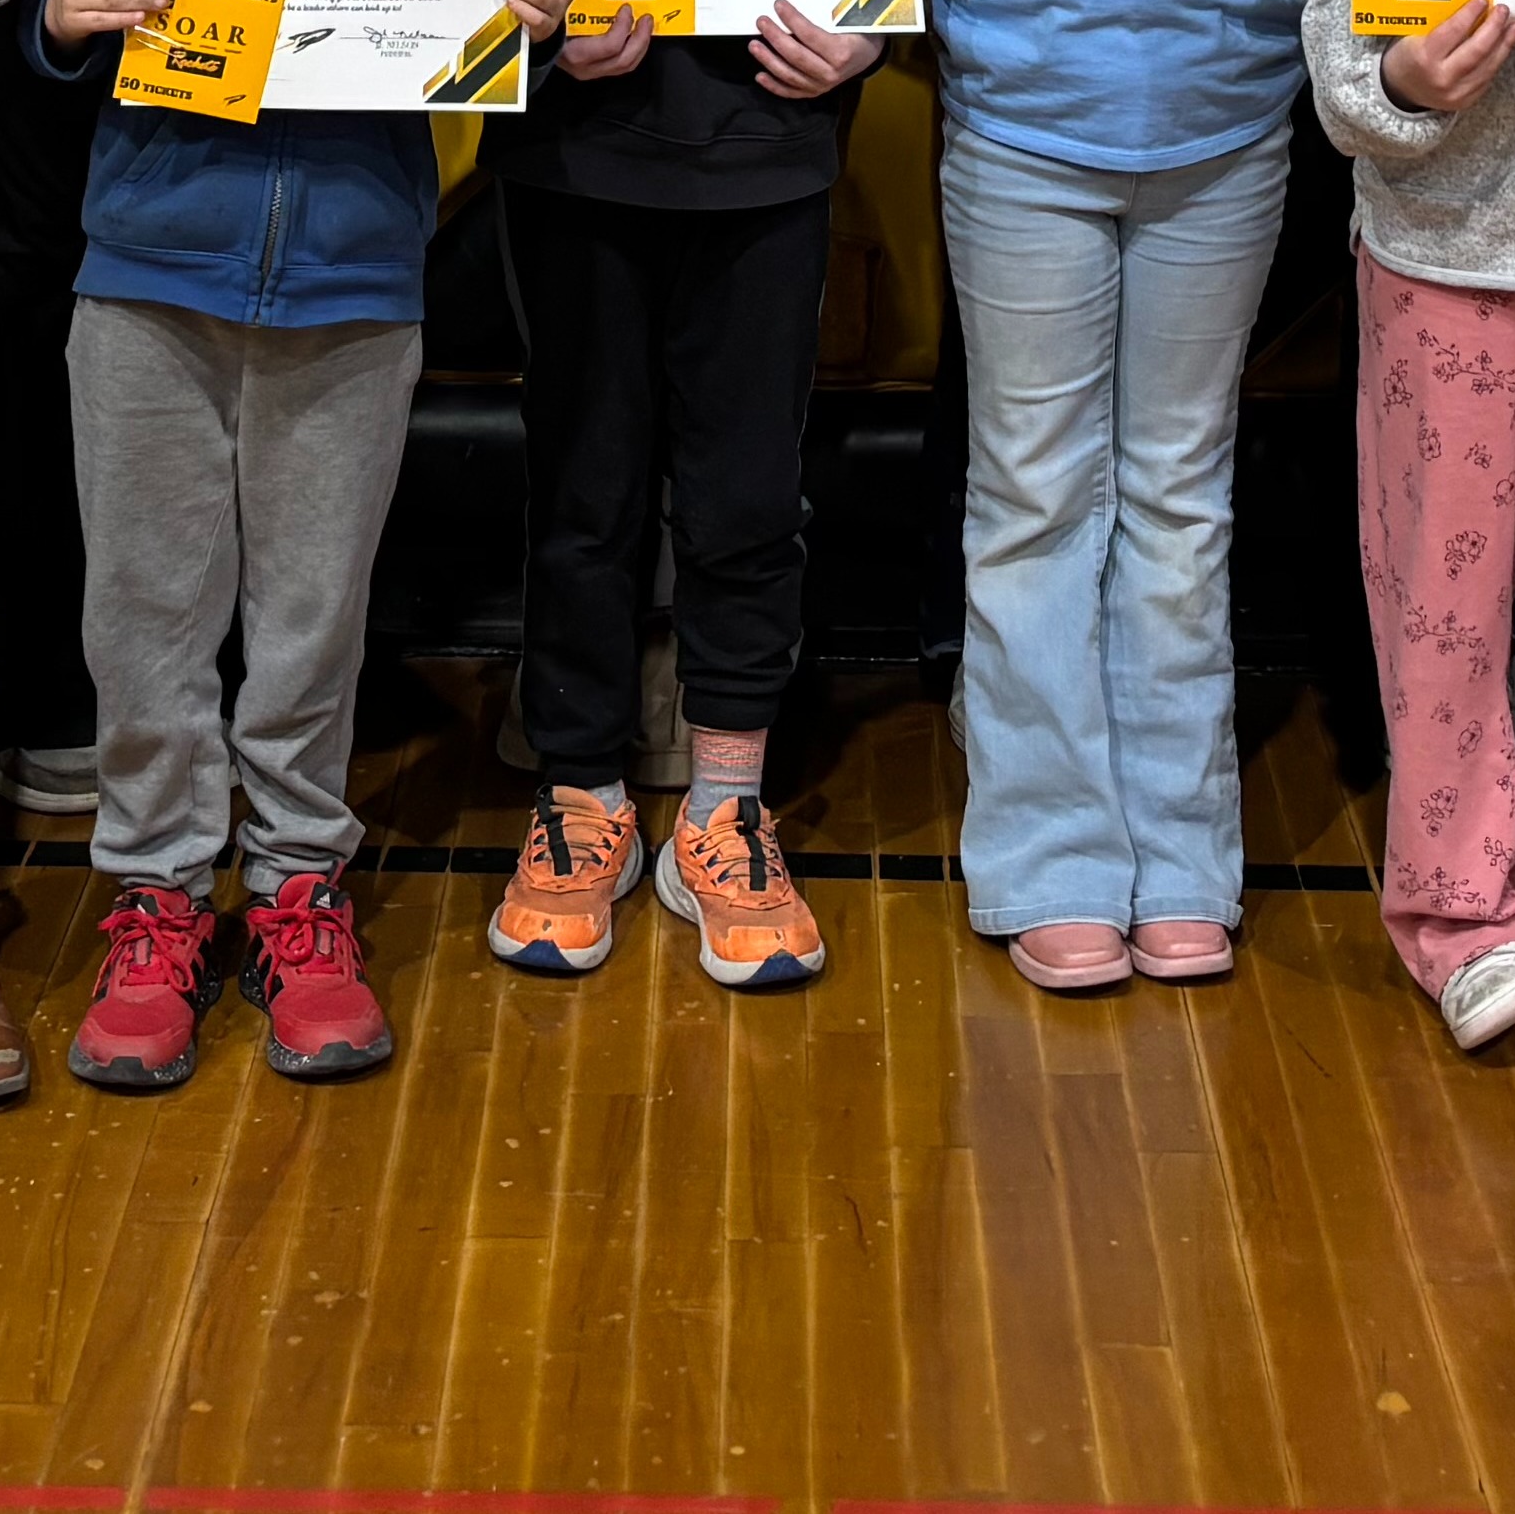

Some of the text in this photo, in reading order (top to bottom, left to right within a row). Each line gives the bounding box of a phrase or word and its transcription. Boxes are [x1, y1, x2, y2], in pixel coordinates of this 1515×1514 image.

[154, 10, 248, 47] SOAR
[568, 14, 587, 26] 50
[1354, 12, 1427, 26] 50 TICKETS
[119, 76, 194, 101] 50 TICKETS
